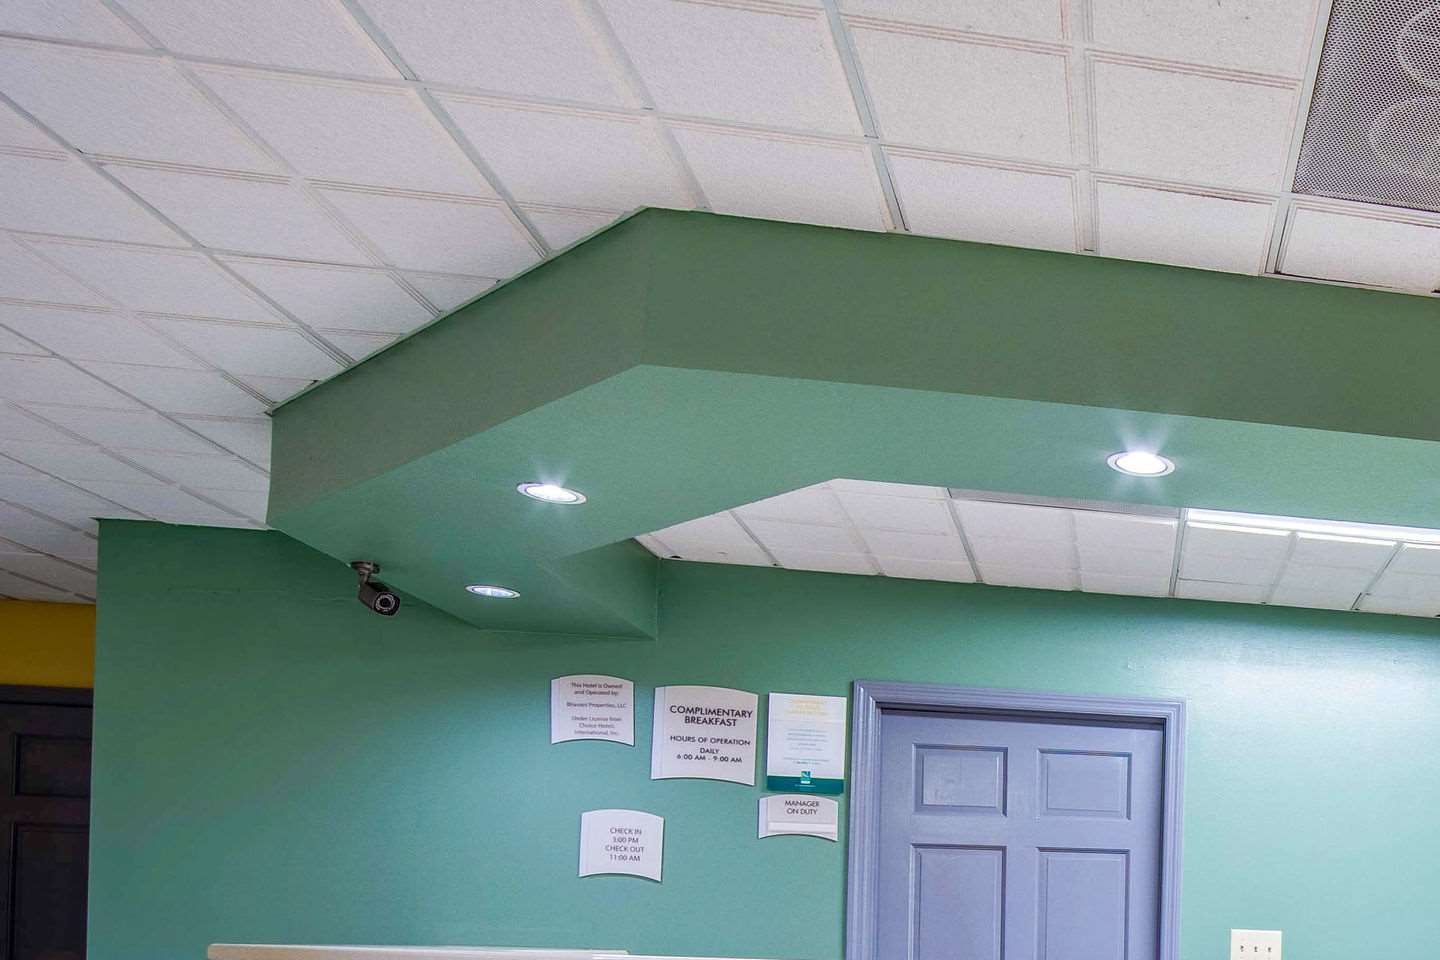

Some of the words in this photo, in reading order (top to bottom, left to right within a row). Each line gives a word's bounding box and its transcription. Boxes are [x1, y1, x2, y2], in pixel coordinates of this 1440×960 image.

[670, 705, 753, 718] COMPLIMENTARY
[684, 715, 738, 727] BREAKFAST
[670, 735, 696, 743] HOURS
[710, 737, 751, 746] OPERATION
[699, 747, 720, 755] DAILY
[609, 827, 633, 835] CHECK
[605, 845, 629, 853] CHECK
